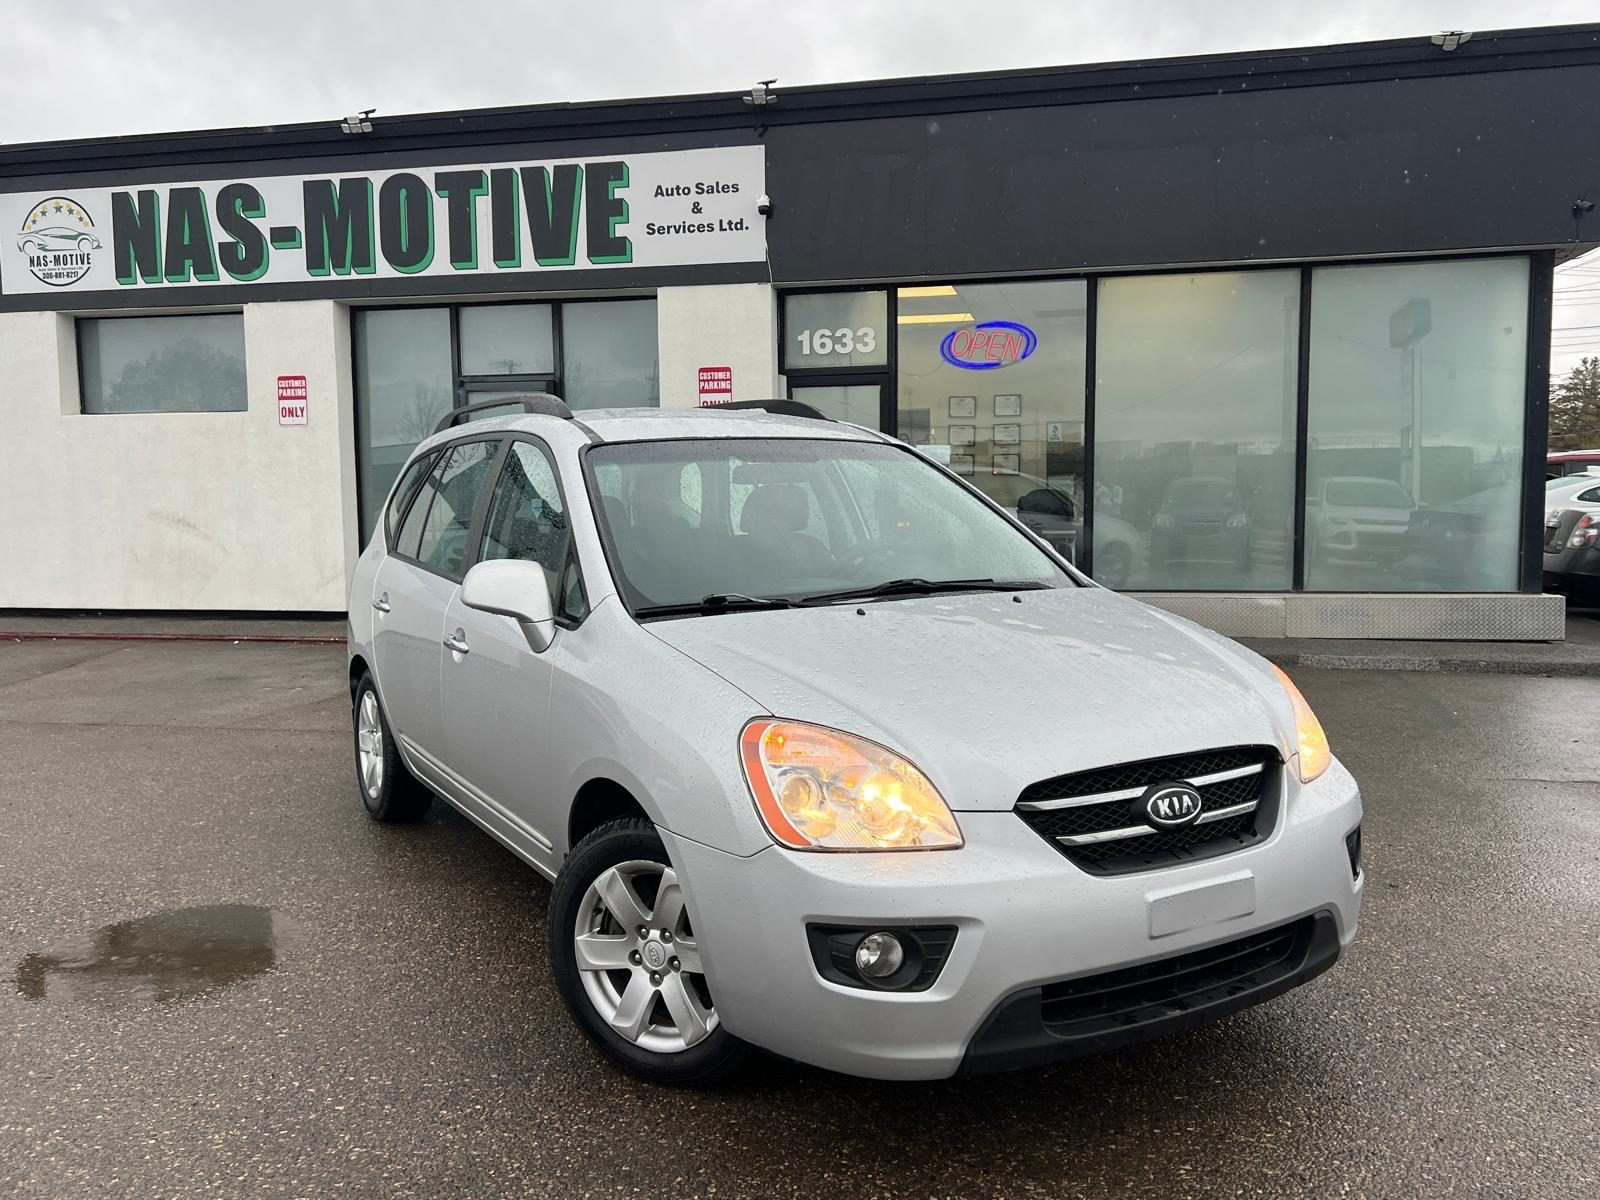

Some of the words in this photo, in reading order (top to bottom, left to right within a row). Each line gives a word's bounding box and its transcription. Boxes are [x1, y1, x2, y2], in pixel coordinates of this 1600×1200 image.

[654, 184, 691, 198] Auto
[694, 181, 740, 195] Sales
[691, 201, 703, 214] &
[111, 161, 632, 285] NAS-MOTIVE
[646, 220, 715, 236] Services
[718, 218, 750, 232] Ltd.
[29, 253, 91, 267] NAS-MOTIVE
[797, 327, 876, 355] 1633
[950, 328, 1024, 361] OPEN
[700, 372, 730, 380] CUSTOMER
[278, 380, 306, 388] CUSTOMER
[700, 380, 730, 390] PARKING
[278, 388, 306, 396] PARKING
[281, 406, 305, 418] ONLY
[1157, 794, 1195, 818] KIA
